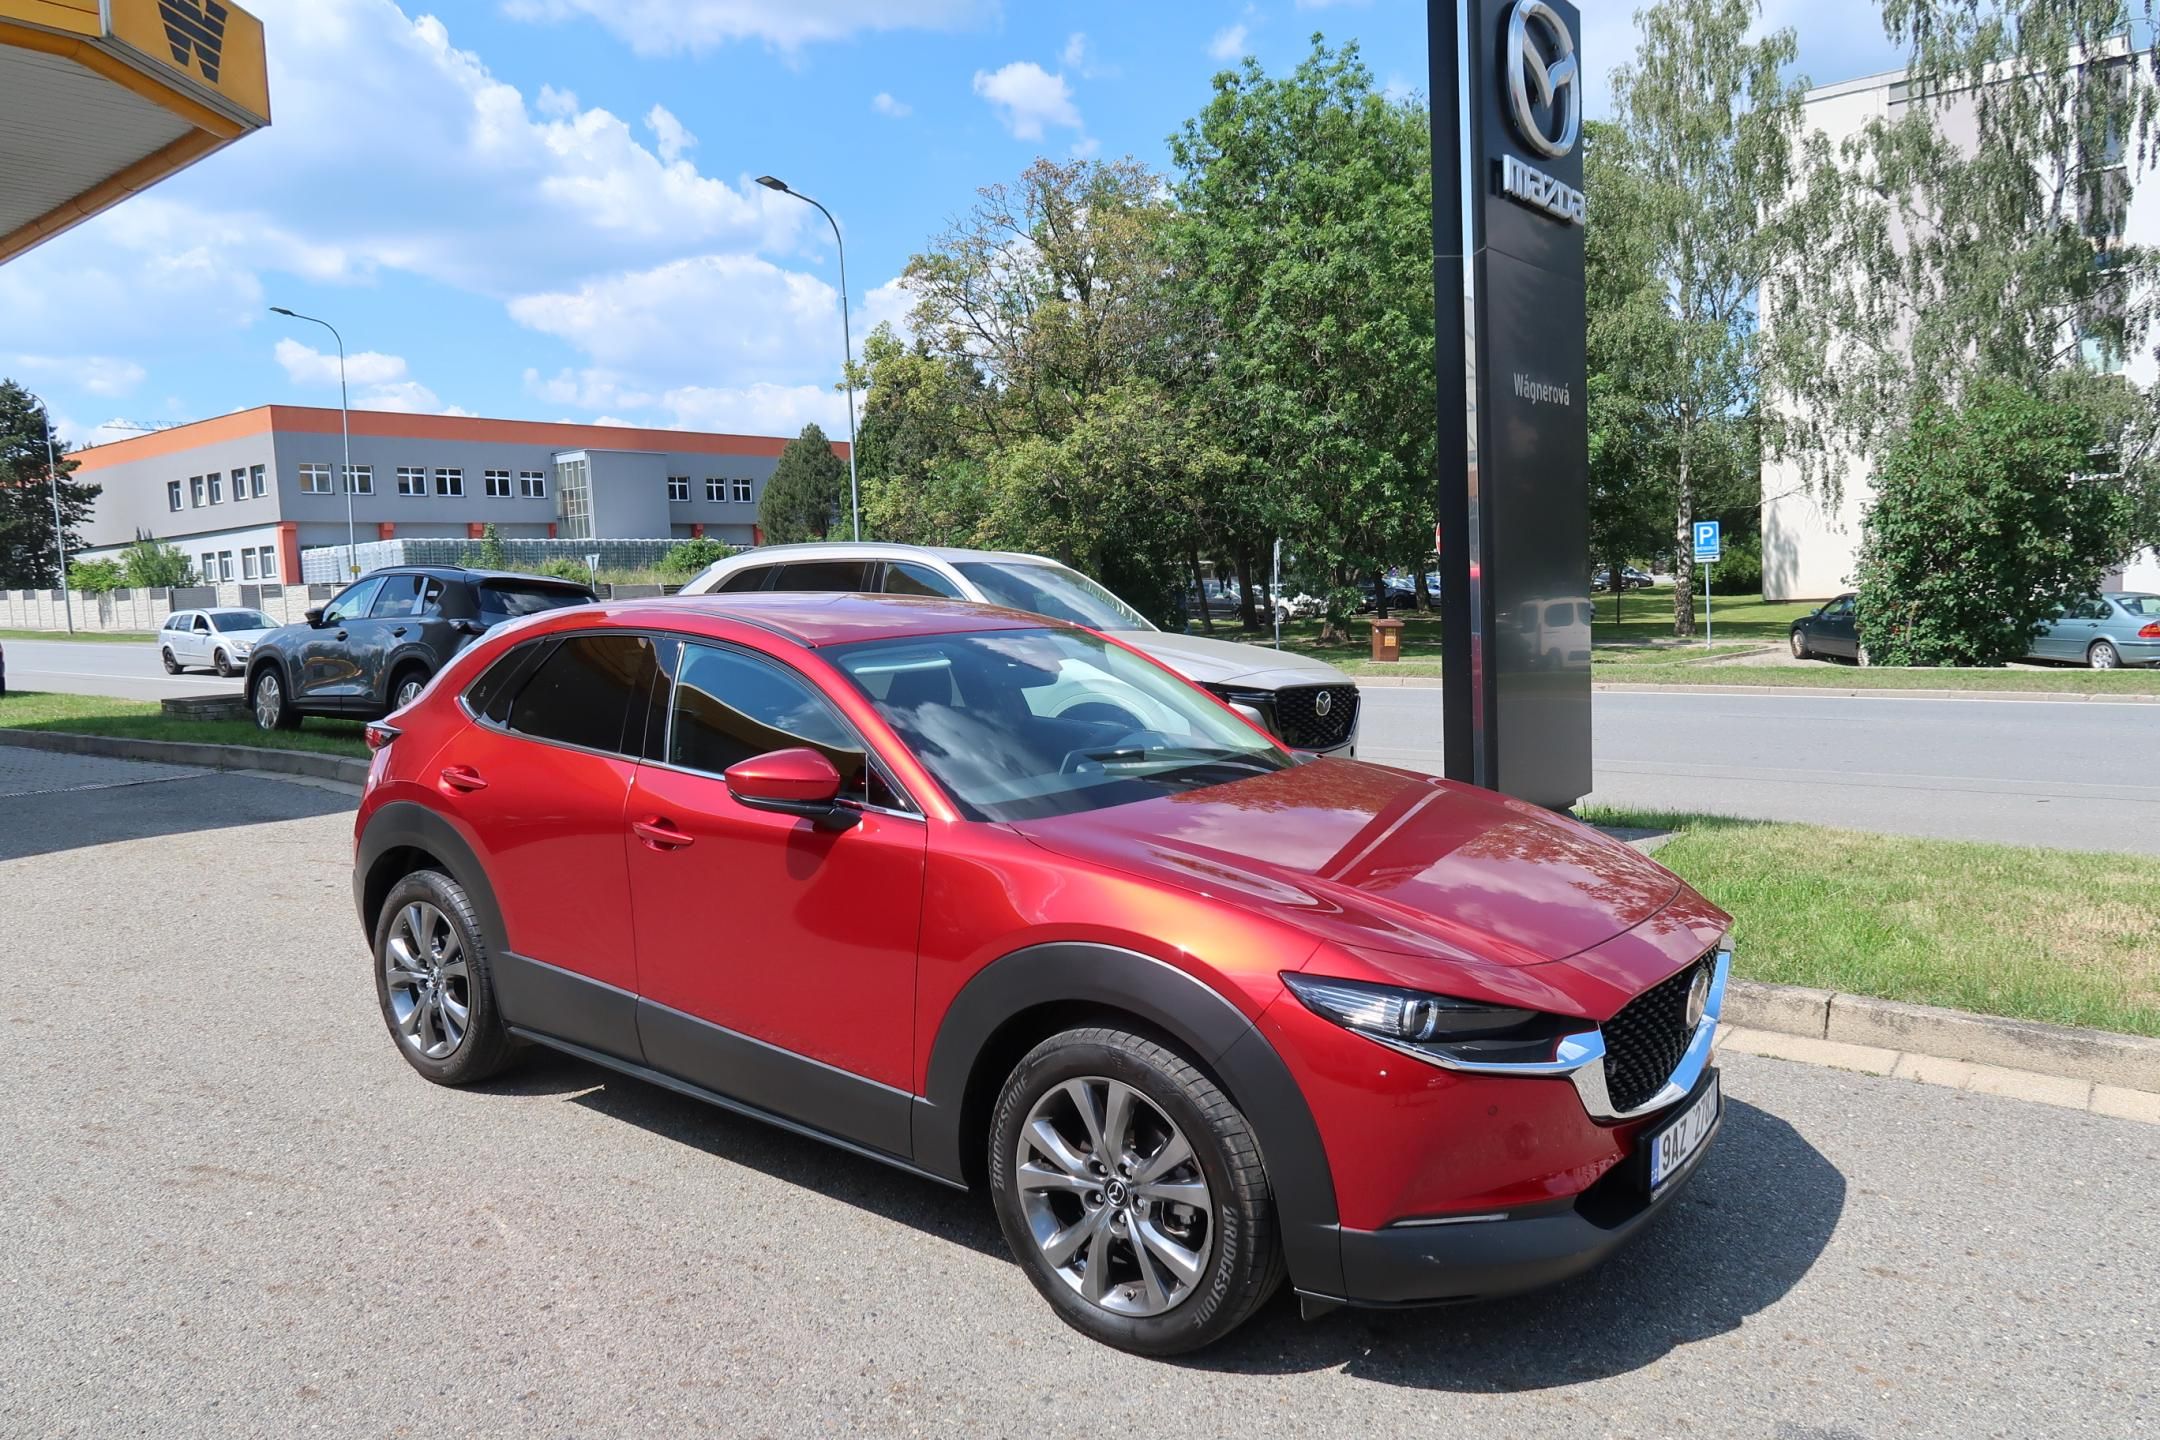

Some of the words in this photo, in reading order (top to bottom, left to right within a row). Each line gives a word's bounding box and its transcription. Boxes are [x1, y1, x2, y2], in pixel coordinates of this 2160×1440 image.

[1513, 372, 1570, 406] Wágnerová
[1699, 526, 1714, 545] P
[993, 1074, 1028, 1191] BRIDGESTONE
[1662, 1118, 1688, 1171] 9AZ
[1193, 1204, 1239, 1329] BRIDGESTONE
